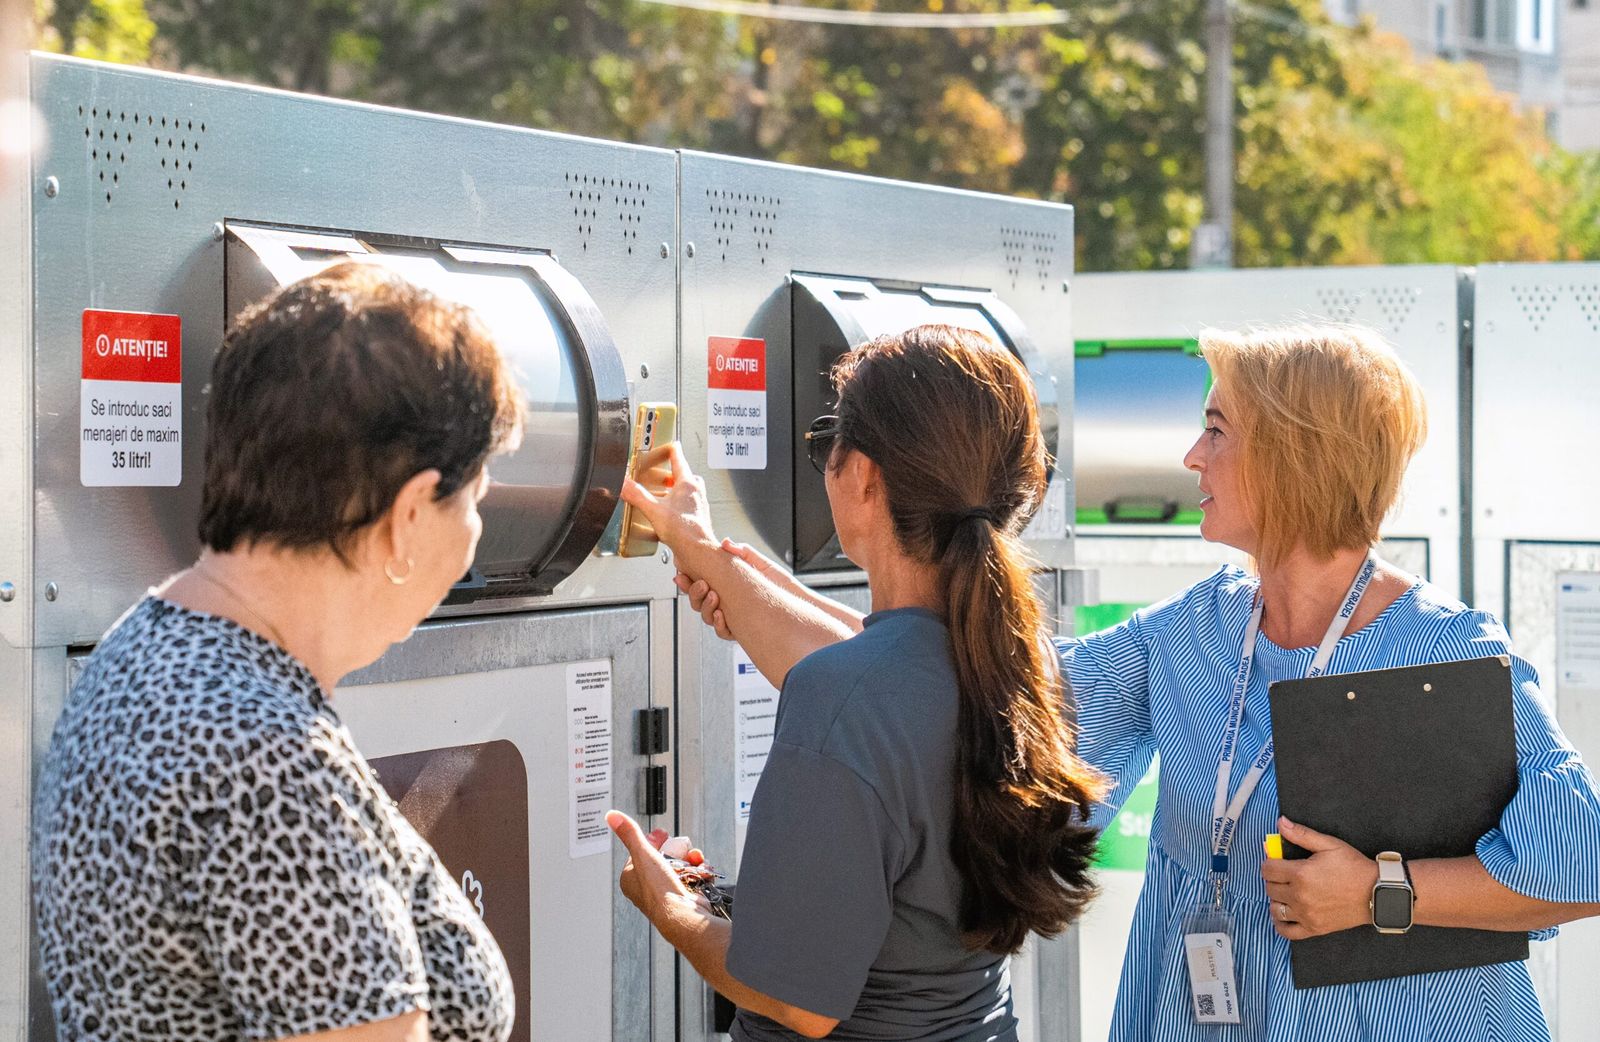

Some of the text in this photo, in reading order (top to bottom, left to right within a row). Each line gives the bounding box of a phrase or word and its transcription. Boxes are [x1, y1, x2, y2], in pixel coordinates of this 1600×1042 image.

[112, 338, 168, 362] ATENȚIE!
[91, 399, 172, 418] Se introduc saci
[713, 403, 761, 418] Se introduc saci
[83, 427, 179, 446] menajeri de maxim
[709, 424, 765, 439] menajeri de maxim
[725, 443, 749, 456] 35 litri!
[112, 452, 151, 469] 35 litri!
[1339, 594, 1359, 619] ORADEA
[1222, 656, 1250, 762] PRIMARIA MUNICIPIULUI ORADEA
